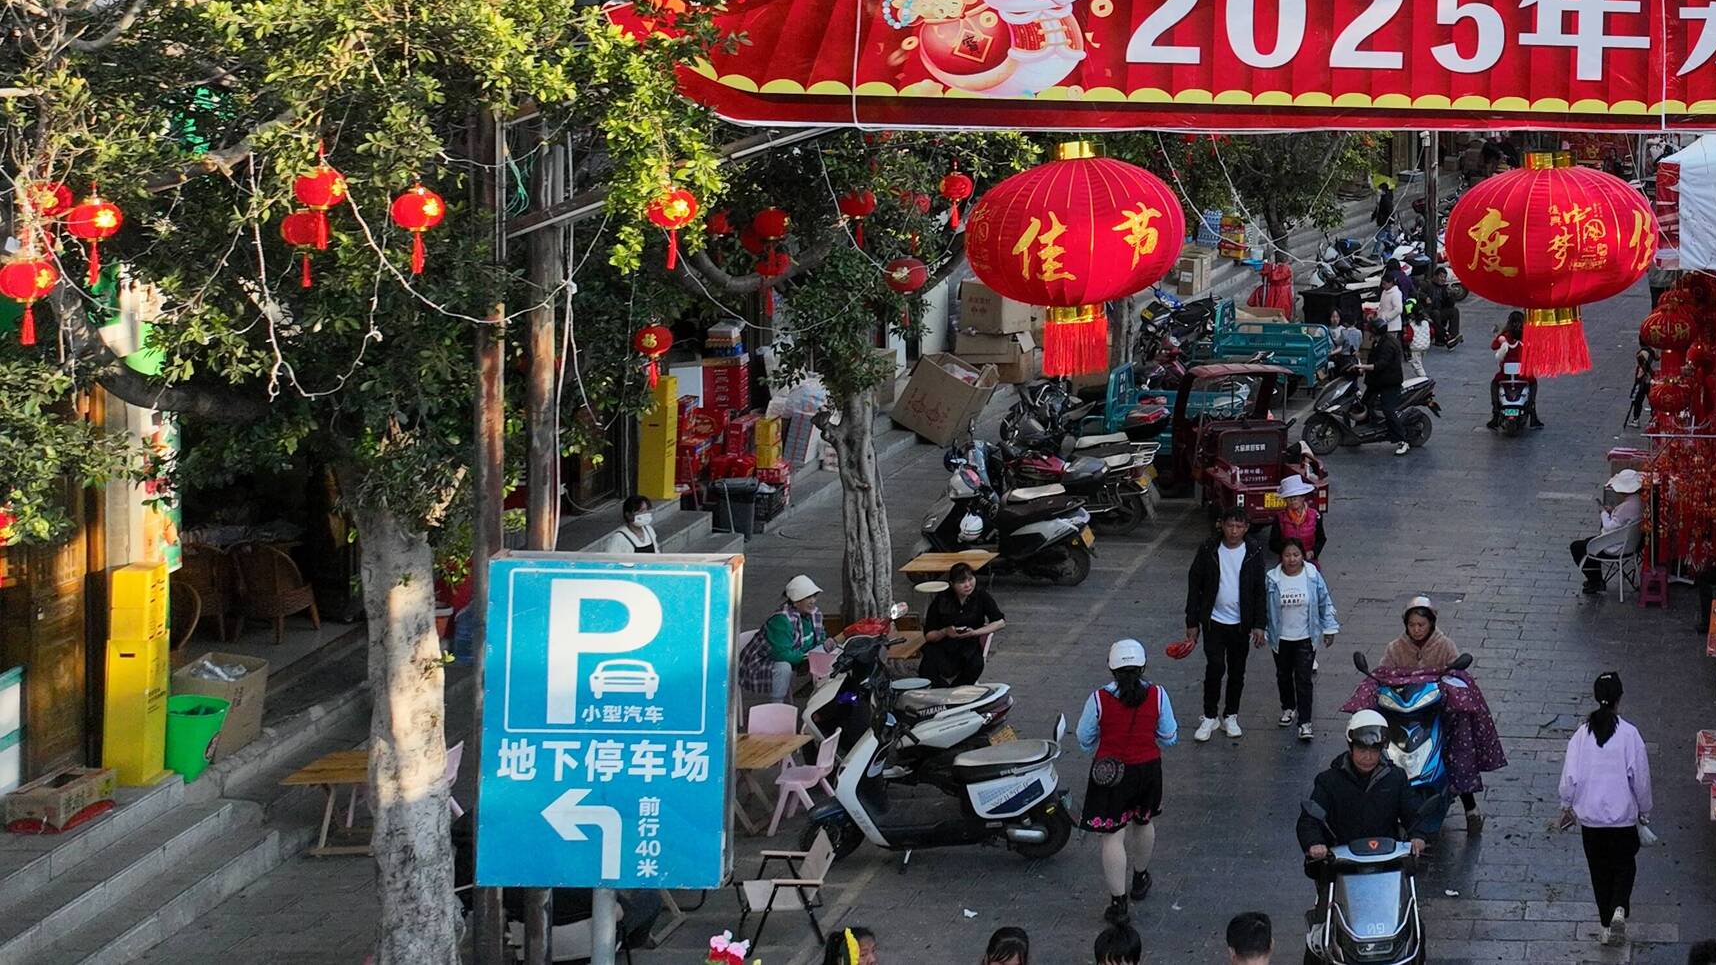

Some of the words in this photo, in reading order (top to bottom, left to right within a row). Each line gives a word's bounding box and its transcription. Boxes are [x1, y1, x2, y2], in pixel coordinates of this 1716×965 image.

[546, 578, 663, 724] P
[581, 705, 664, 724] 小型汽车
[496, 738, 710, 782] 地下停车场
[634, 796, 662, 878] 前行40米
